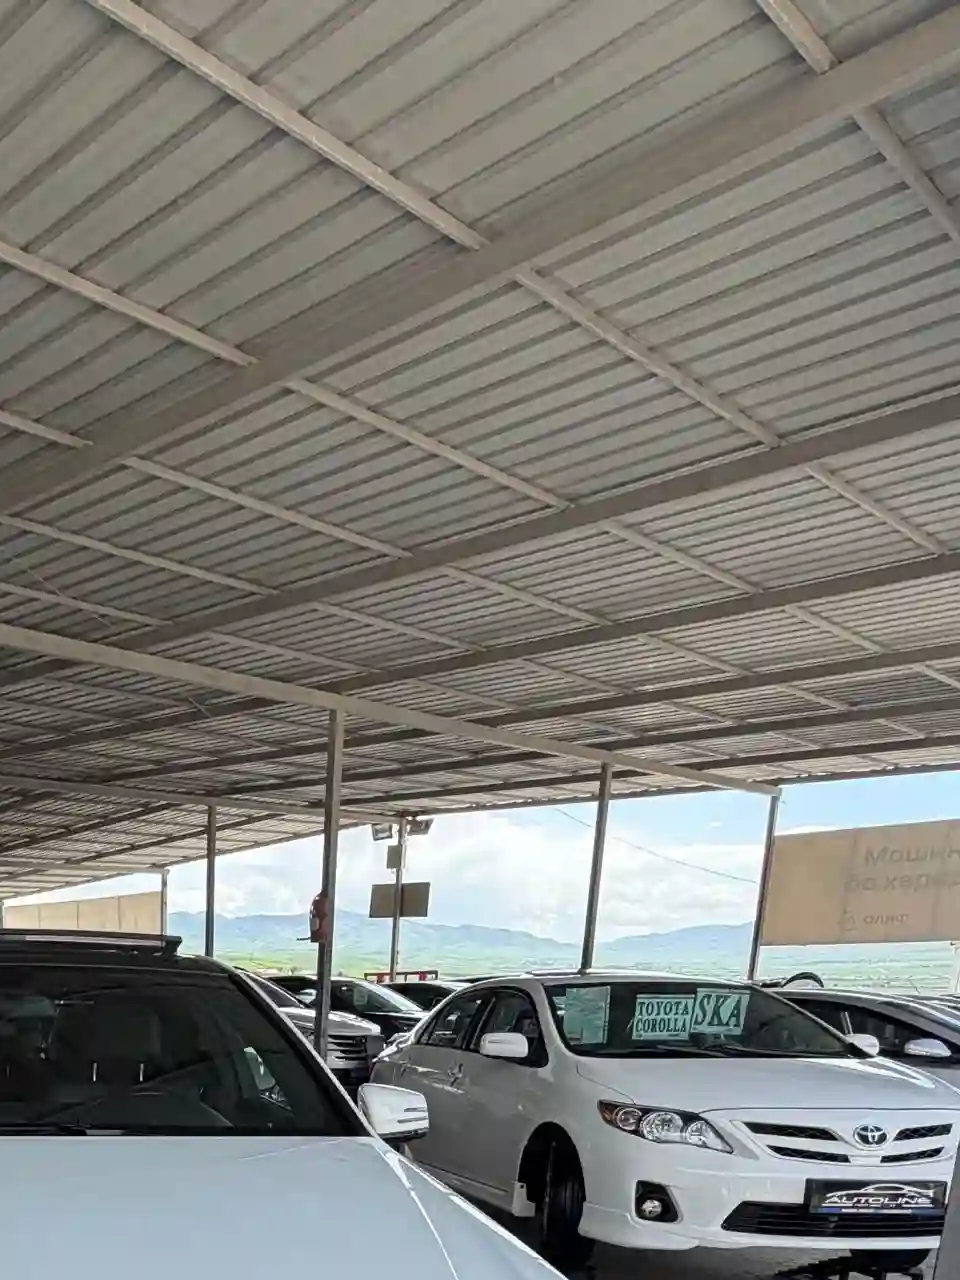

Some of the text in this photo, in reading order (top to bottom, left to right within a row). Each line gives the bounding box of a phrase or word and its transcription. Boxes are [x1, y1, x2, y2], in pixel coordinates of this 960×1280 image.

[637, 1000, 690, 1017] TOYOTA
[693, 993, 742, 1027] SKA
[635, 1016, 687, 1033] COROLLA
[824, 1196, 932, 1204] AUTOLINE
